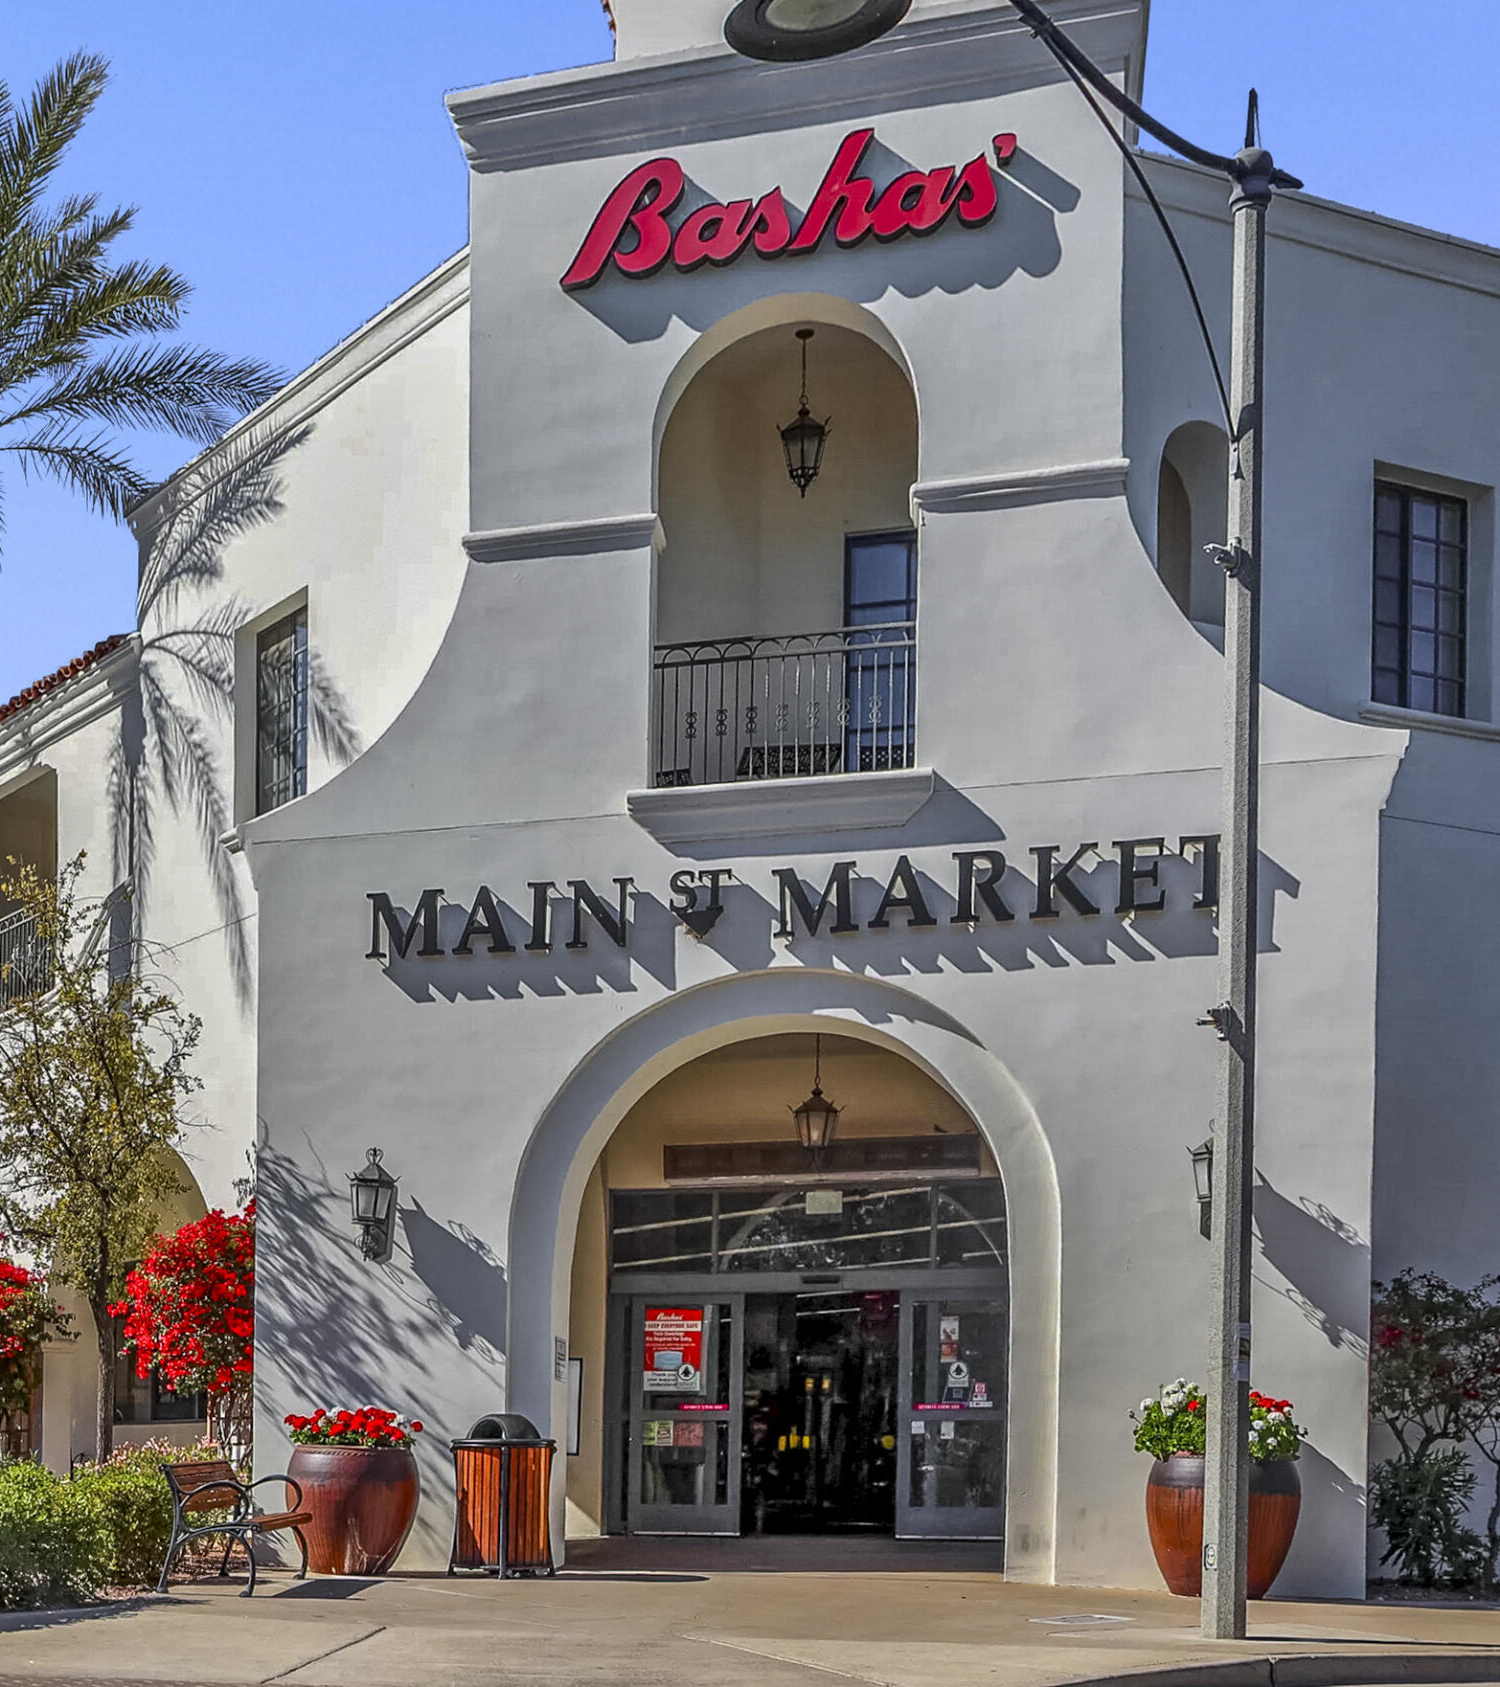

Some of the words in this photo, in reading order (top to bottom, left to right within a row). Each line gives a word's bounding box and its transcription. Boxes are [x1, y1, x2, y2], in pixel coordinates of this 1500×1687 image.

[560, 128, 1017, 292] Bashas'
[365, 876, 634, 959] MAIN
[669, 868, 732, 912] ST
[771, 834, 1221, 938] MARKET
